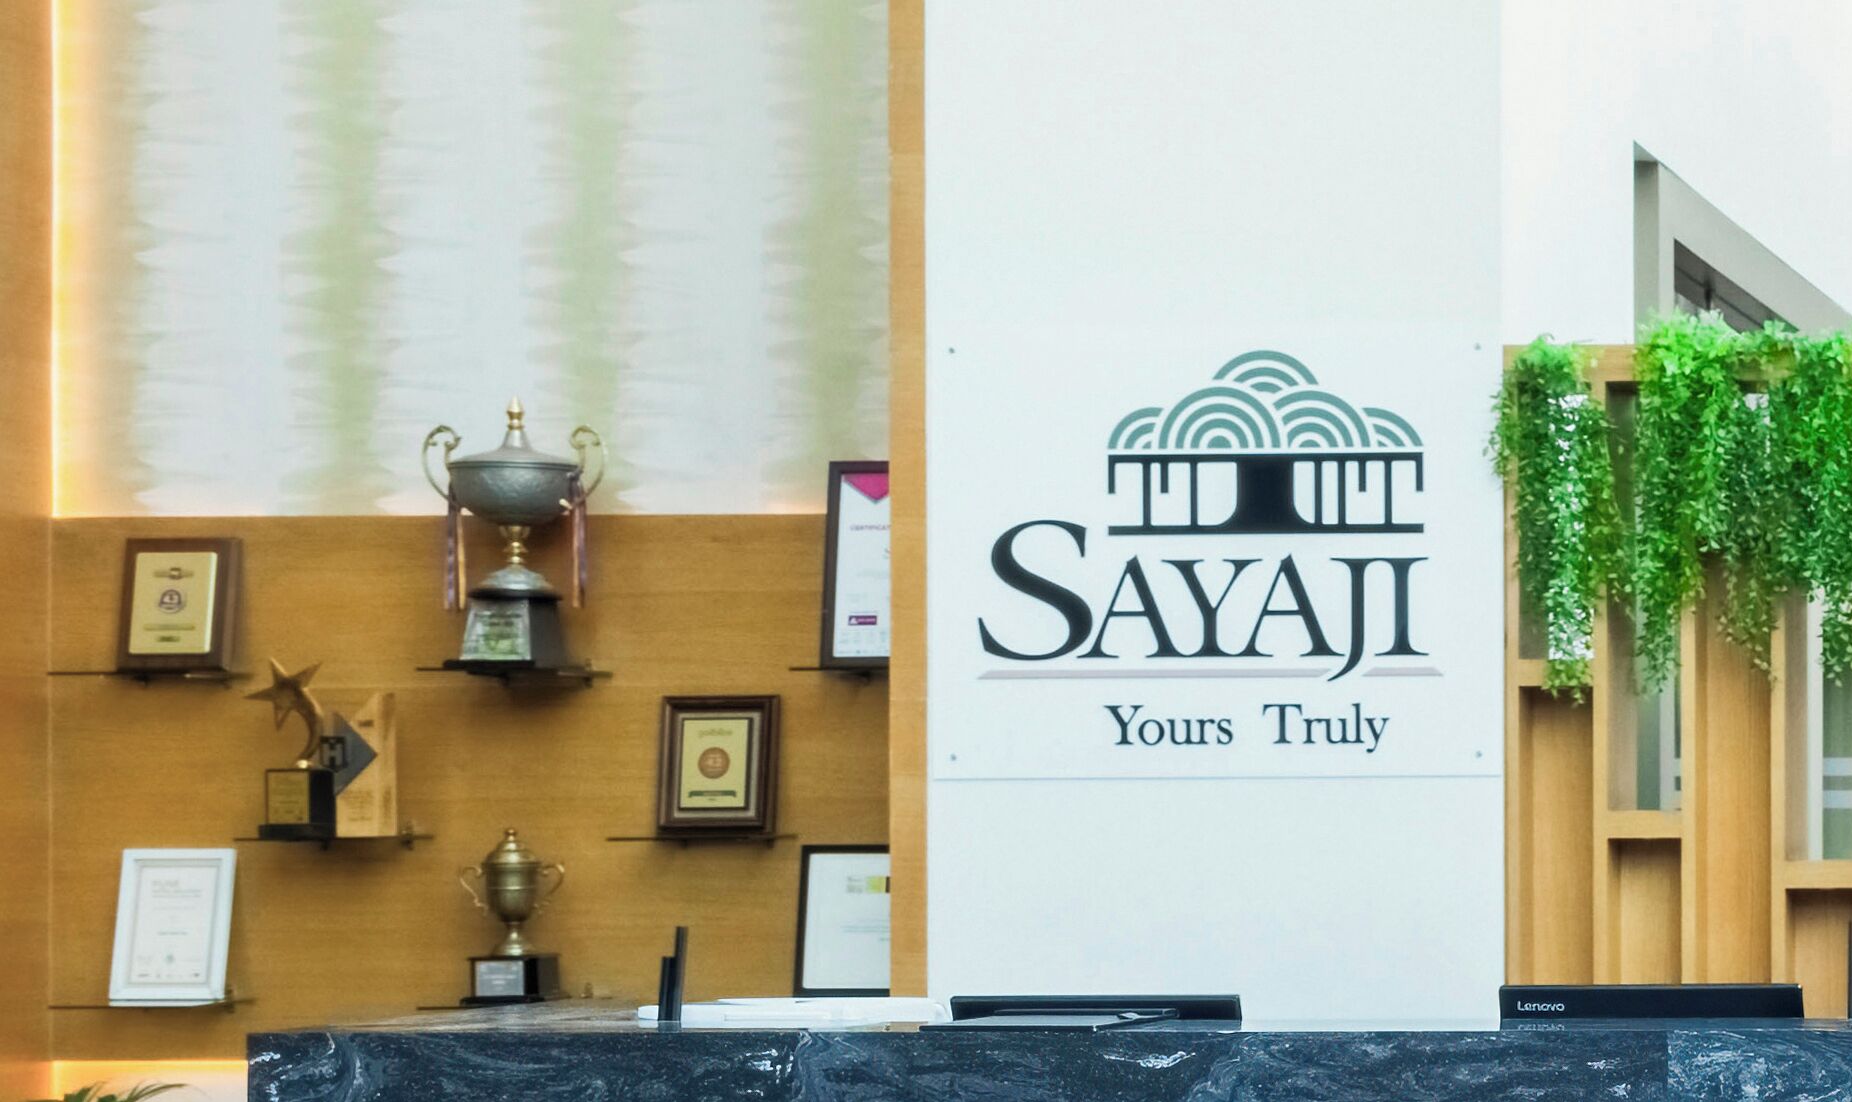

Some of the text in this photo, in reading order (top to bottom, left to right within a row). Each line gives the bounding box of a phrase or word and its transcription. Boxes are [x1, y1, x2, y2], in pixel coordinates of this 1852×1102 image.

[977, 519, 1430, 682] SAYAJI
[1103, 704, 1390, 754] Yours Truly
[1516, 1000, 1566, 1012] Lenovo
